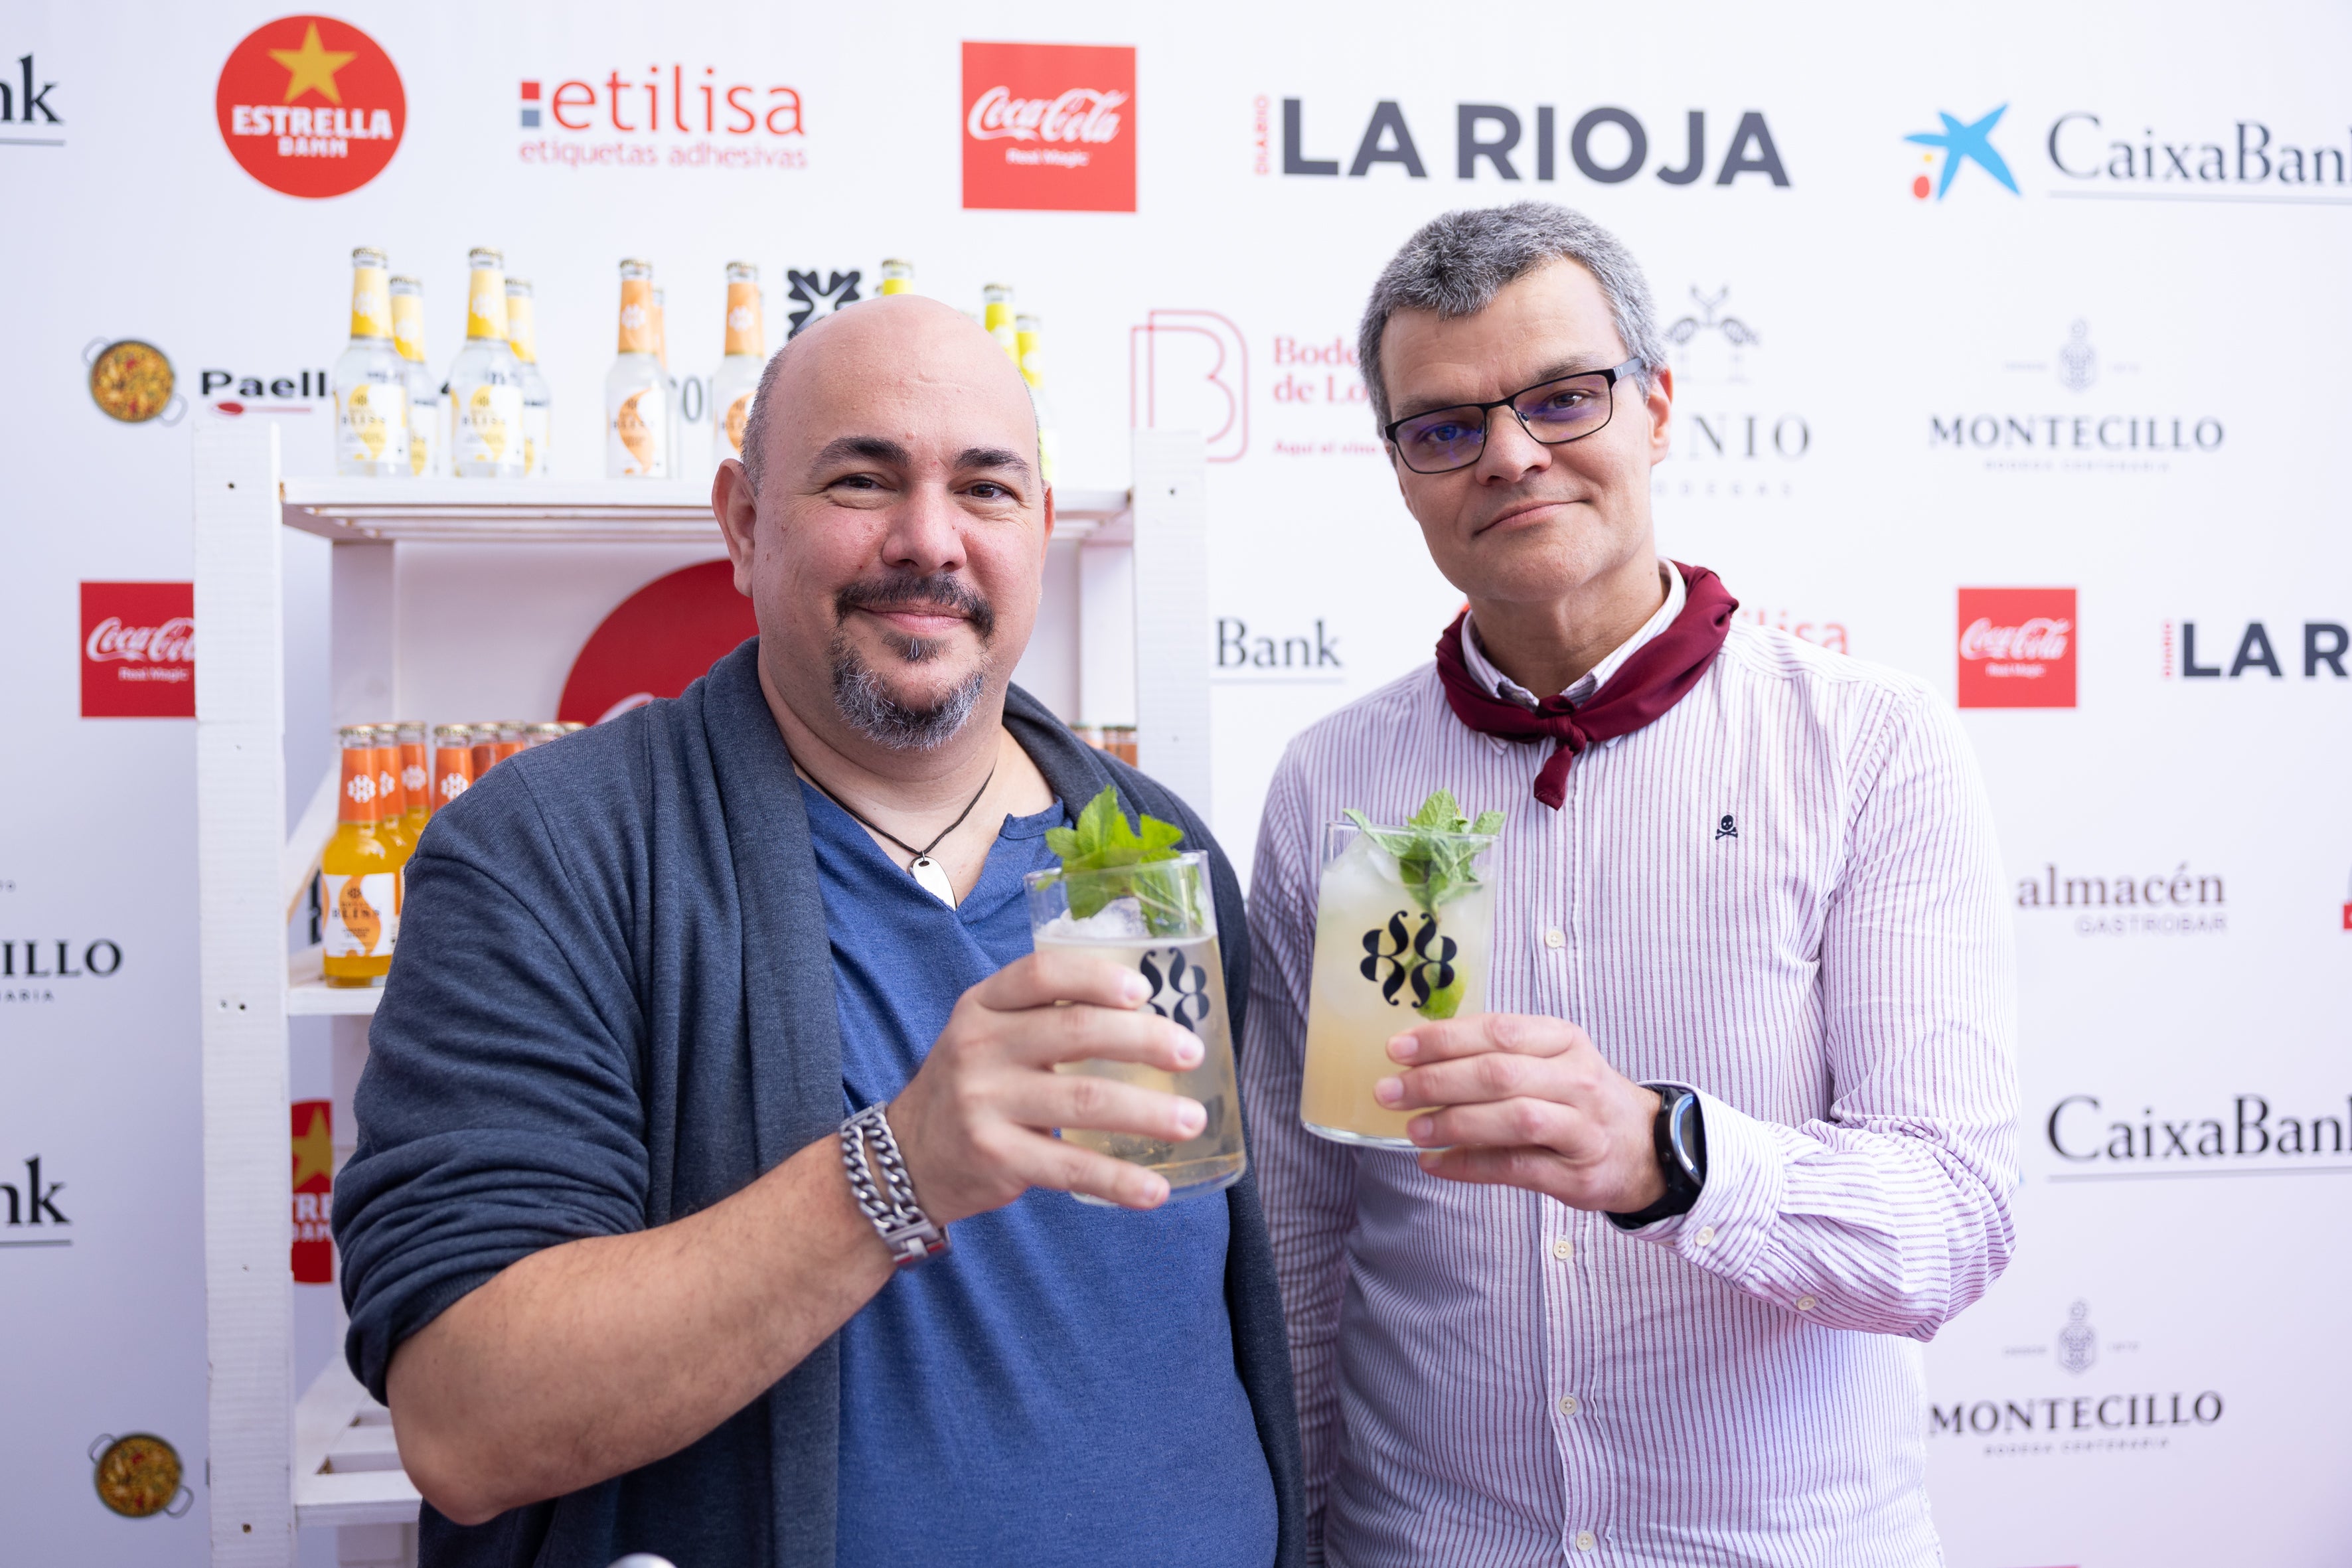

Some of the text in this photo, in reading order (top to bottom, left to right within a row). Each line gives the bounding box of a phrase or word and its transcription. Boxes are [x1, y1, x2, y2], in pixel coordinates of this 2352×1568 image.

[232, 104, 394, 139] ESTRELLA
[552, 64, 805, 135] etilisa
[520, 141, 807, 169] etiquetas adhesivas
[1282, 98, 1792, 187] LA RIOJA
[2048, 112, 2352, 185] CaixaBan
[200, 370, 327, 398] Paell
[1929, 413, 2224, 452] MONTECILLO
[86, 616, 195, 662] Coca-Col
[2183, 622, 2282, 677] LA
[2017, 862, 2227, 907] almacén
[2047, 1093, 2352, 1161] CaixaBan
[1929, 1390, 2224, 1437] MONTECILLO
